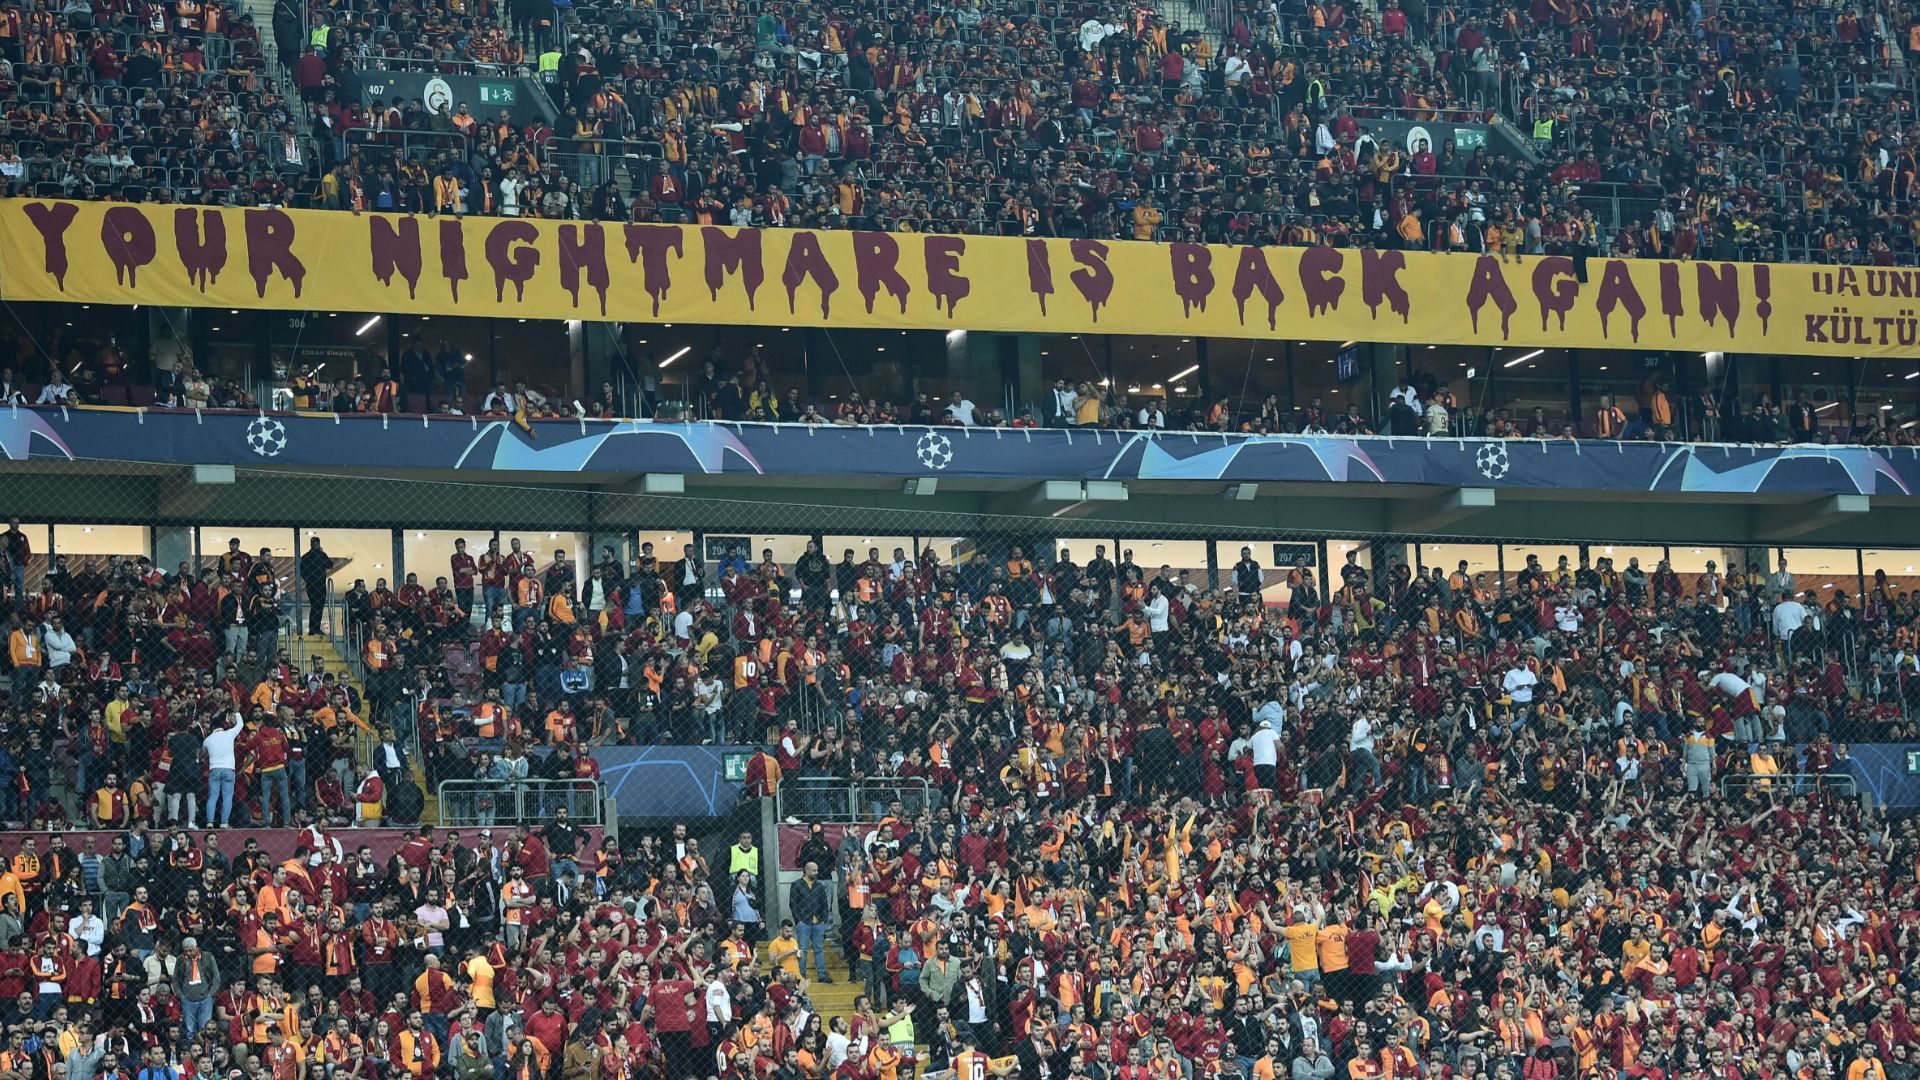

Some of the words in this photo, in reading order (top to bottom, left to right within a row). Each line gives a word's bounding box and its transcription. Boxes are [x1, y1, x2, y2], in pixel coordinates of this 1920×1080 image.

[369, 85, 384, 95] 407
[23, 202, 306, 299] YOUR
[370, 216, 970, 320] NIGHTMARE
[1027, 239, 1114, 323] IS
[1170, 243, 1410, 331] BACK
[1466, 256, 1772, 343] AGAIN!
[289, 318, 306, 329] 306
[1644, 357, 1658, 367] 307
[1278, 552, 1293, 562] 207
[741, 661, 756, 678] 10
[967, 1063, 985, 1080] 10
